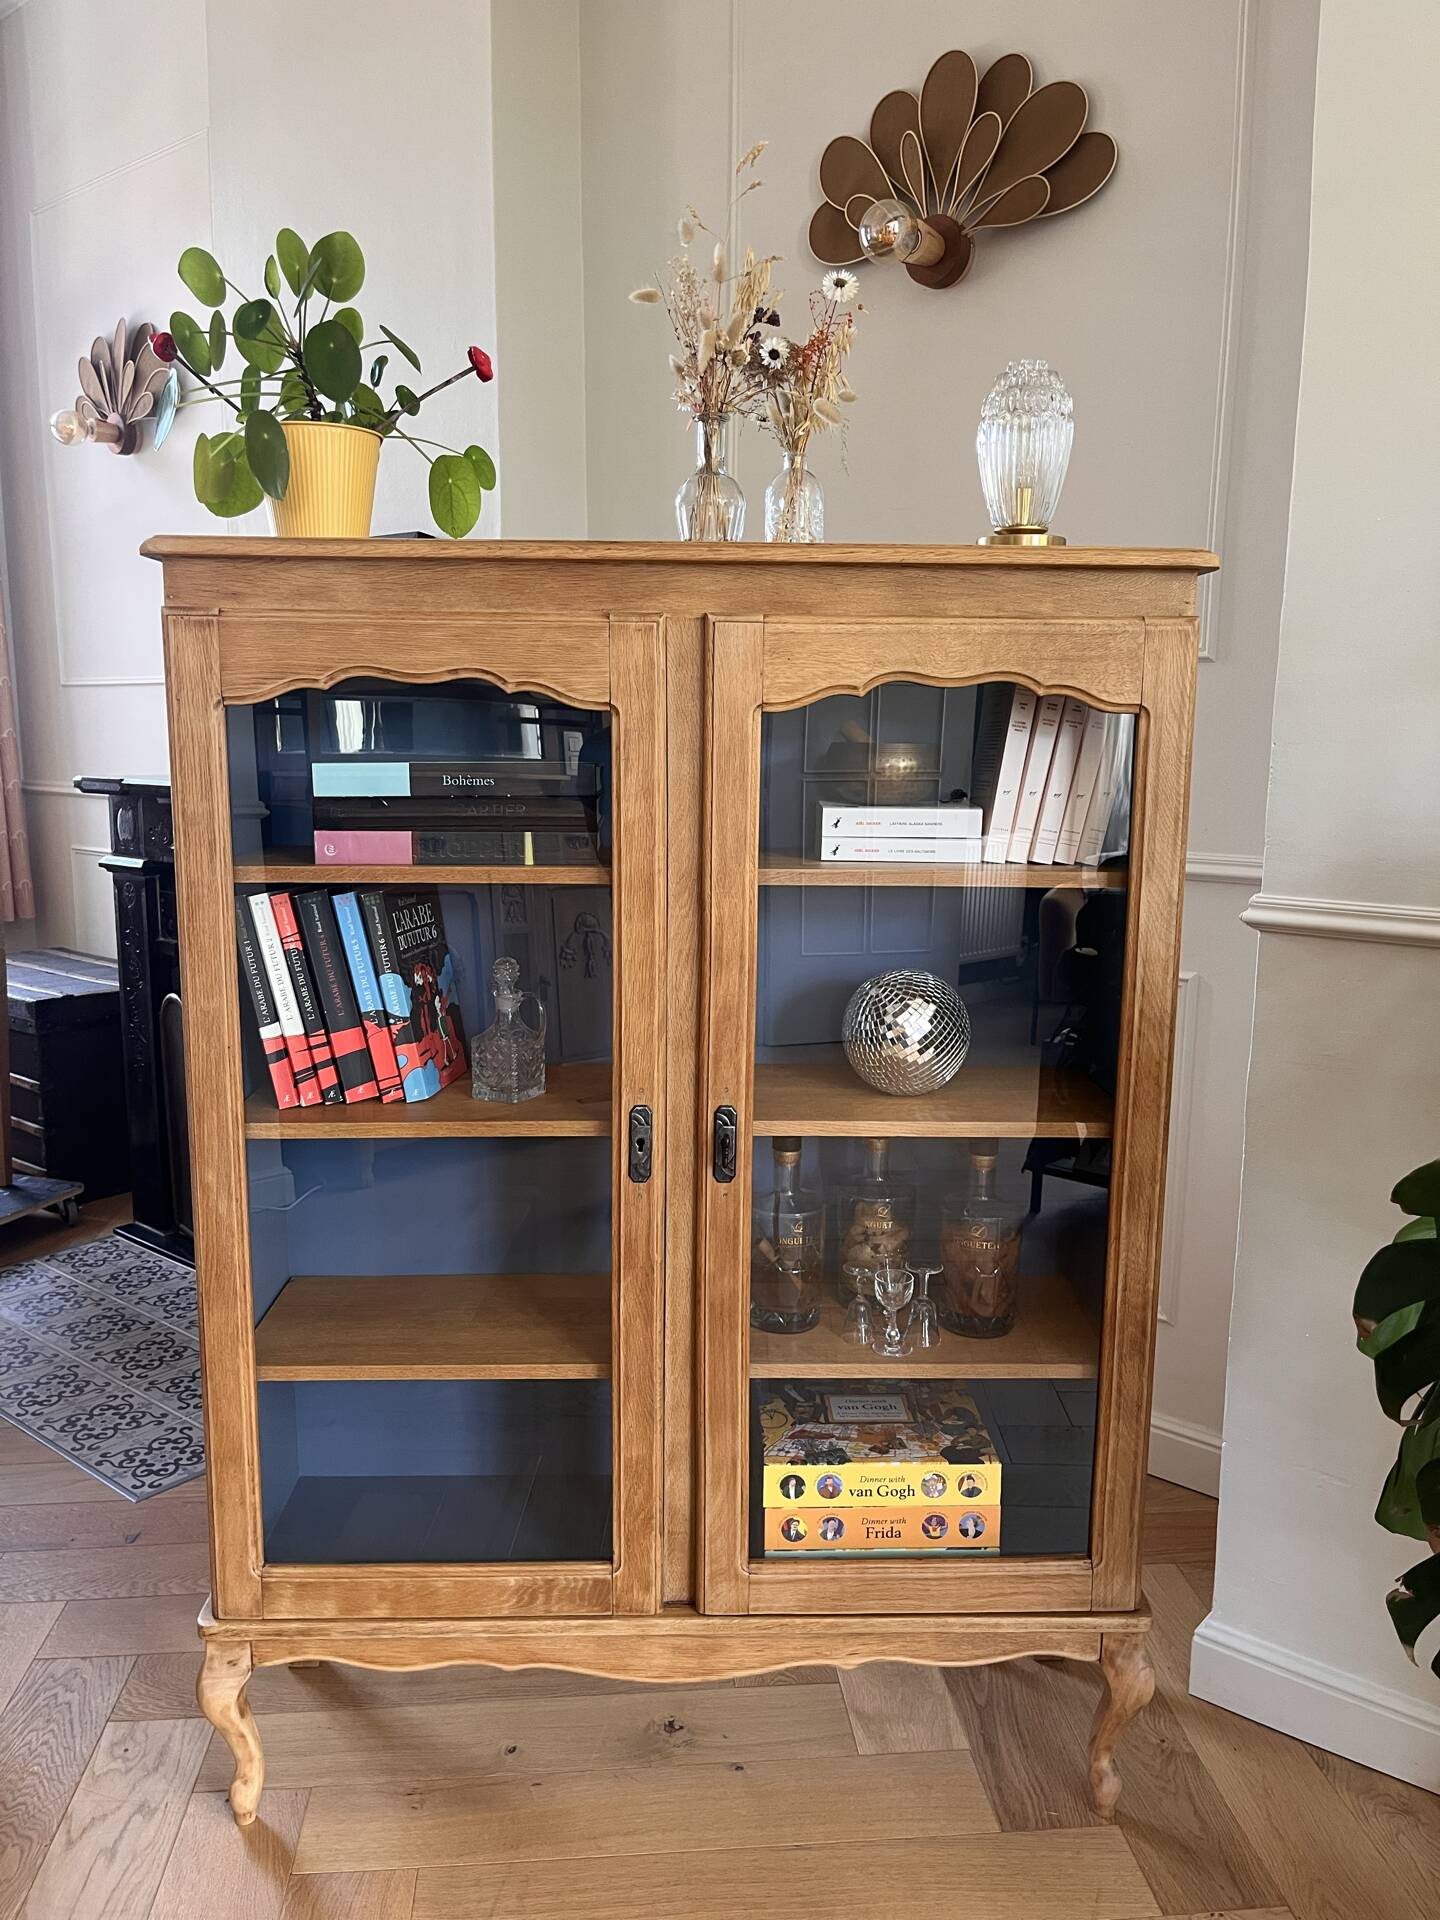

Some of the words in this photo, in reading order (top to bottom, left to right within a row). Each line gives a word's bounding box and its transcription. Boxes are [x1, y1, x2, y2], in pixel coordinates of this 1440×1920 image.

[442, 774, 496, 787] Bohèmes
[392, 902, 435, 933] L'ARABE
[397, 934, 408, 951] DU
[406, 926, 433, 947] FUTUR
[431, 924, 438, 938] 6
[245, 945, 257, 973] FUTUR
[380, 942, 391, 972] FUTUR
[256, 988, 271, 1023] L'ARABE
[300, 985, 314, 1020] L'ARABE
[862, 1403, 898, 1412] Gogh
[860, 1475, 888, 1484] Dinner
[888, 1475, 906, 1483] with
[849, 1487, 873, 1497] van
[877, 1484, 915, 1500] Gogh
[861, 1517, 889, 1526] Dinner
[889, 1517, 907, 1525] with
[866, 1526, 902, 1539] Frida
